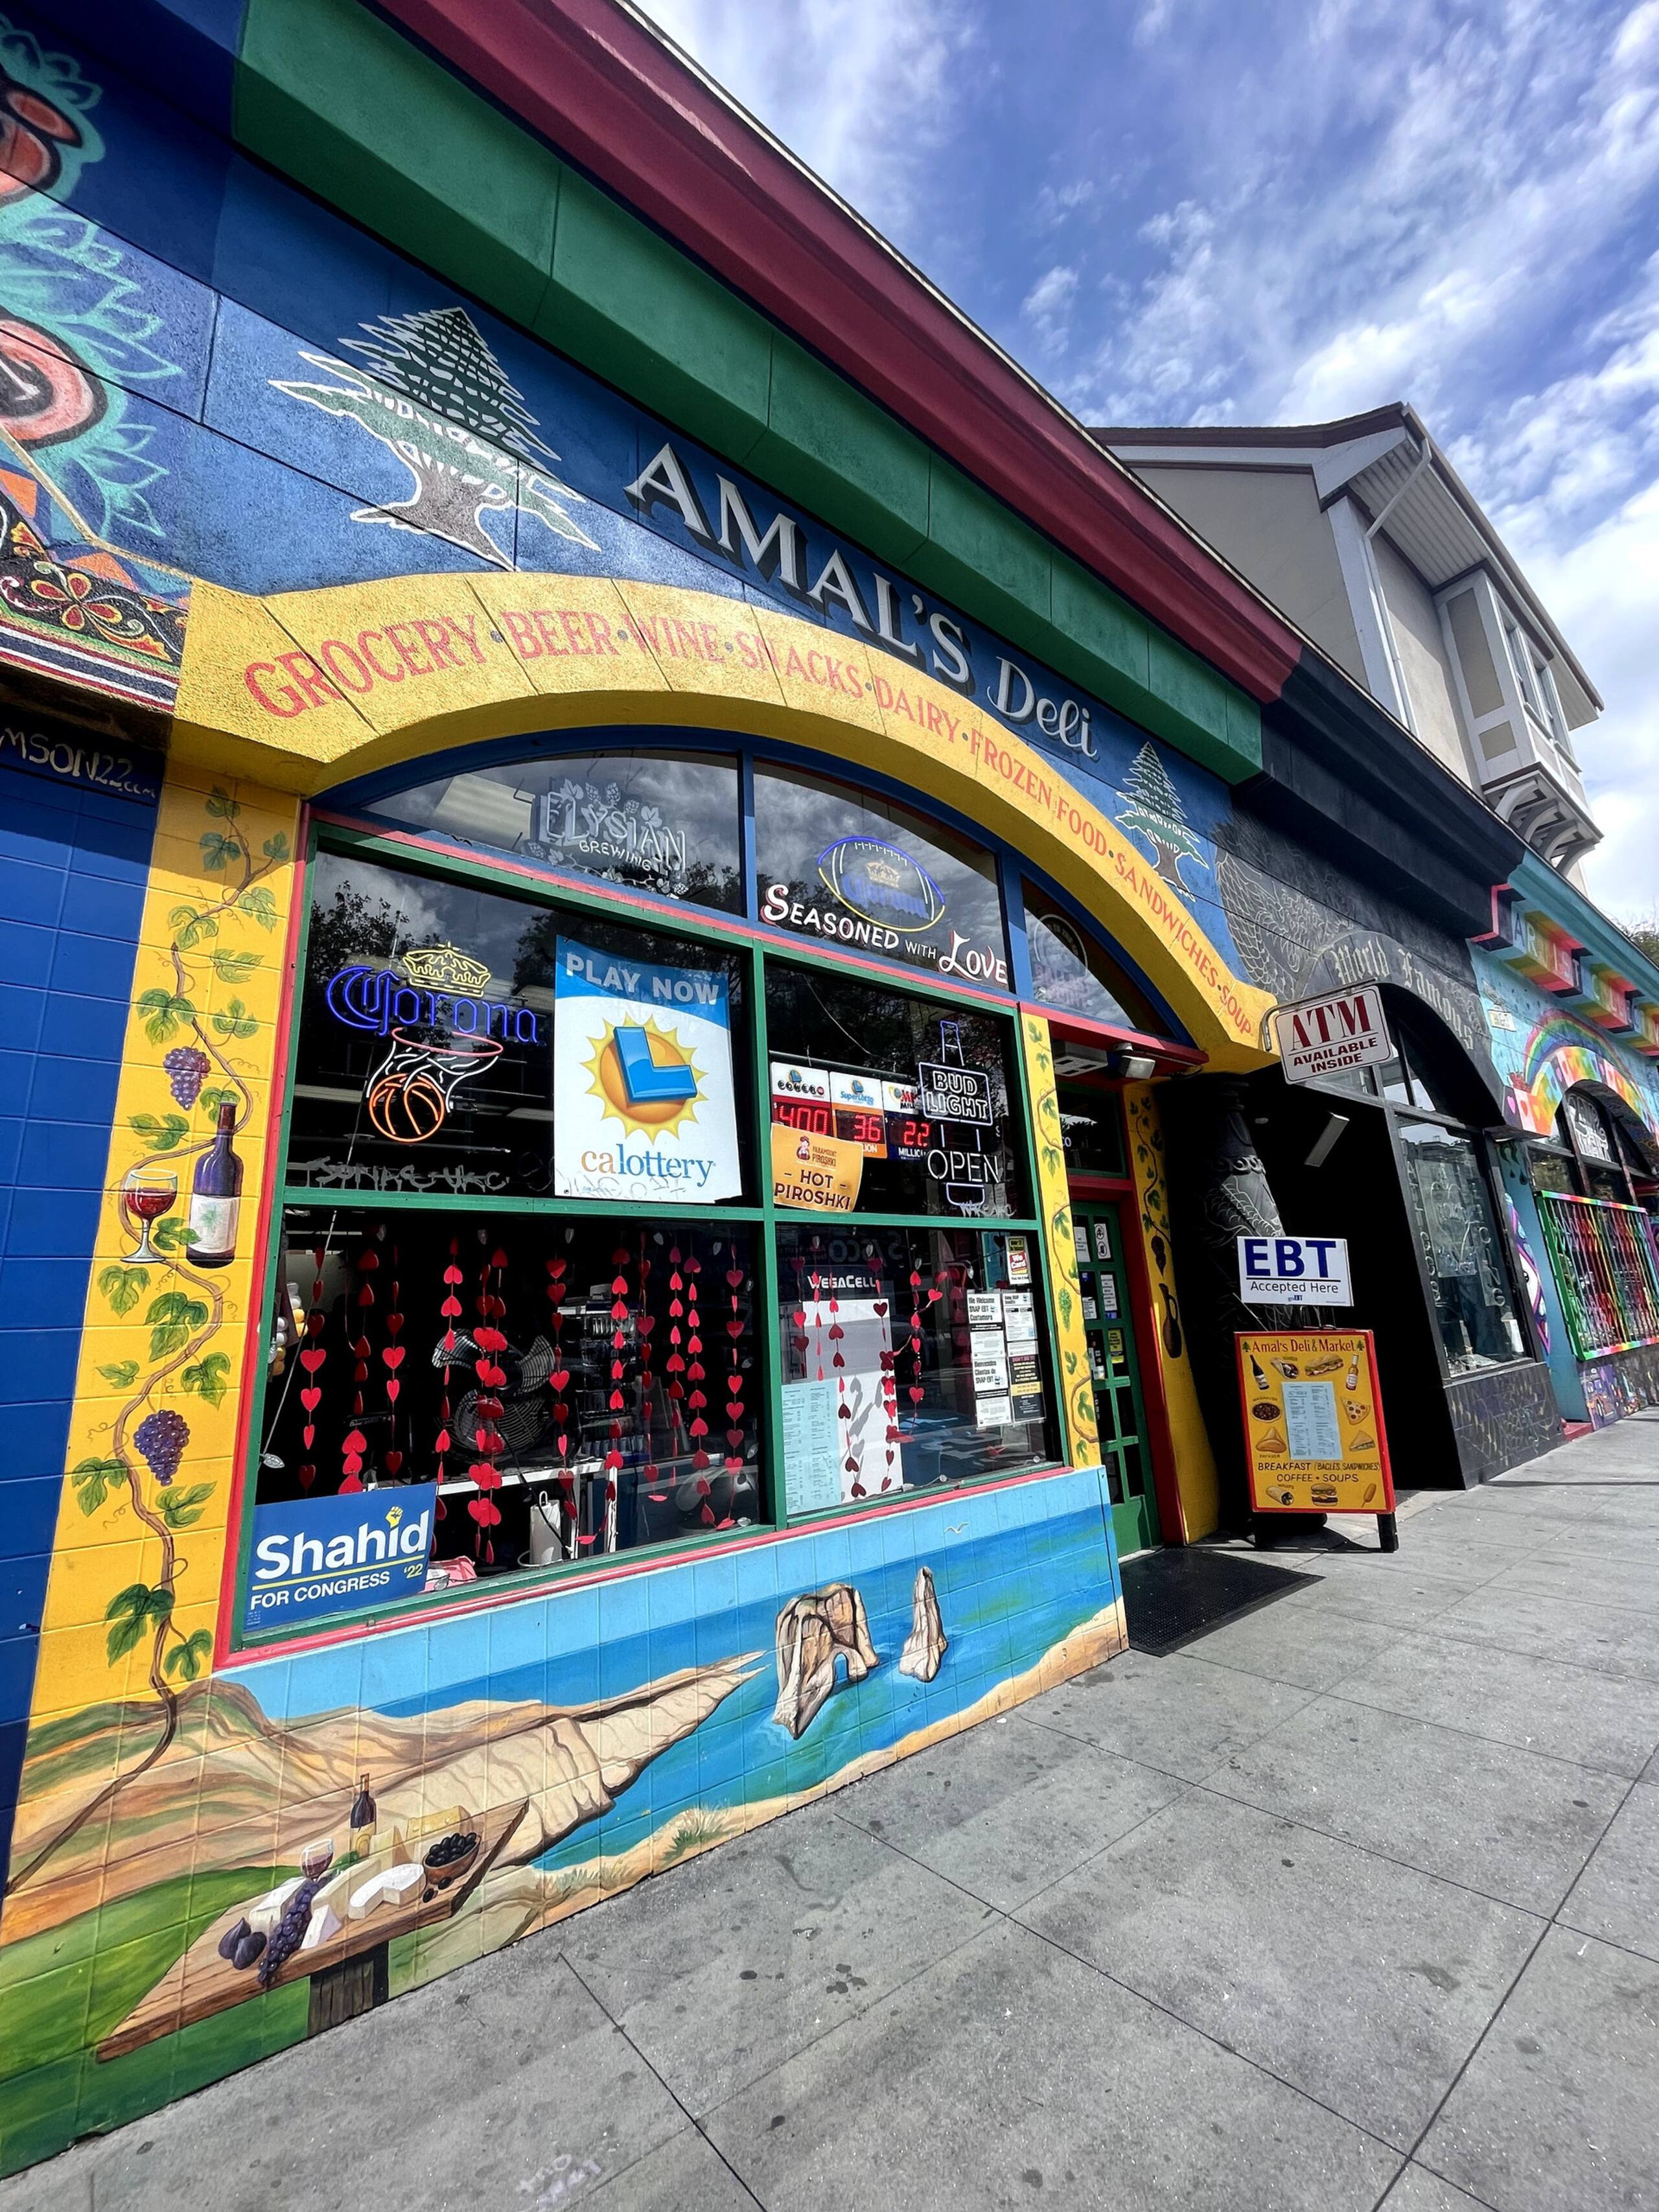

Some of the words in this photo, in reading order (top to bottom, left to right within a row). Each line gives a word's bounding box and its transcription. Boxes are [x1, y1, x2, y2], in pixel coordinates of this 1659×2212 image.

[623, 443, 970, 684] AMAL'S
[987, 657, 1096, 758] Deli
[244, 614, 486, 717] GROCERY
[503, 611, 620, 658] BEER
[622, 613, 726, 664] WINE
[734, 631, 863, 698] SNACKS
[875, 675, 961, 743] DAIRY
[970, 728, 1052, 810] FROZEN
[1056, 796, 1107, 856] FOOD
[1115, 852, 1219, 988] SANDWICHES
[1220, 984, 1251, 1034] SOUP
[542, 791, 686, 874] ELYSIAN
[579, 840, 653, 872] BREWING
[761, 883, 900, 950] SEASONED
[905, 940, 937, 960] WITH
[938, 930, 1008, 983] LOVE
[566, 952, 642, 993] PLAY
[653, 976, 719, 1006] NOW
[1330, 936, 1390, 985] World
[1398, 948, 1474, 1050] Famous
[326, 965, 539, 1043] Corona
[1291, 994, 1375, 1051] ATM
[1294, 1037, 1378, 1066] AVAILABLE
[1311, 1052, 1363, 1073] INSIDE
[840, 1090, 874, 1104] SuperLotto
[933, 1070, 978, 1096] BUD
[926, 1091, 988, 1119] LIGHT
[853, 1115, 881, 1142] 36
[903, 1121, 931, 1147] 22
[581, 1143, 714, 1187] calottery
[811, 1154, 837, 1167] PIROSHKI
[927, 1148, 999, 1184] OPEN
[800, 1169, 834, 1189] HOT
[773, 1182, 852, 1211] PIROSHKI
[1244, 1239, 1336, 1278] EBT
[1250, 1281, 1306, 1294] Accepted
[1310, 1282, 1339, 1294] Here
[1251, 1339, 1288, 1353] Amal's
[1290, 1338, 1310, 1352] Deli
[1311, 1338, 1317, 1352] &
[1318, 1338, 1355, 1352] Market
[1257, 1462, 1312, 1471] BREAKFAST
[1276, 1473, 1313, 1482] COFFEE
[1323, 1473, 1359, 1483] SOUPS
[255, 1509, 430, 1579] Shahid
[250, 1589, 289, 1611] FOR
[294, 1570, 391, 1602] CONGRESS
